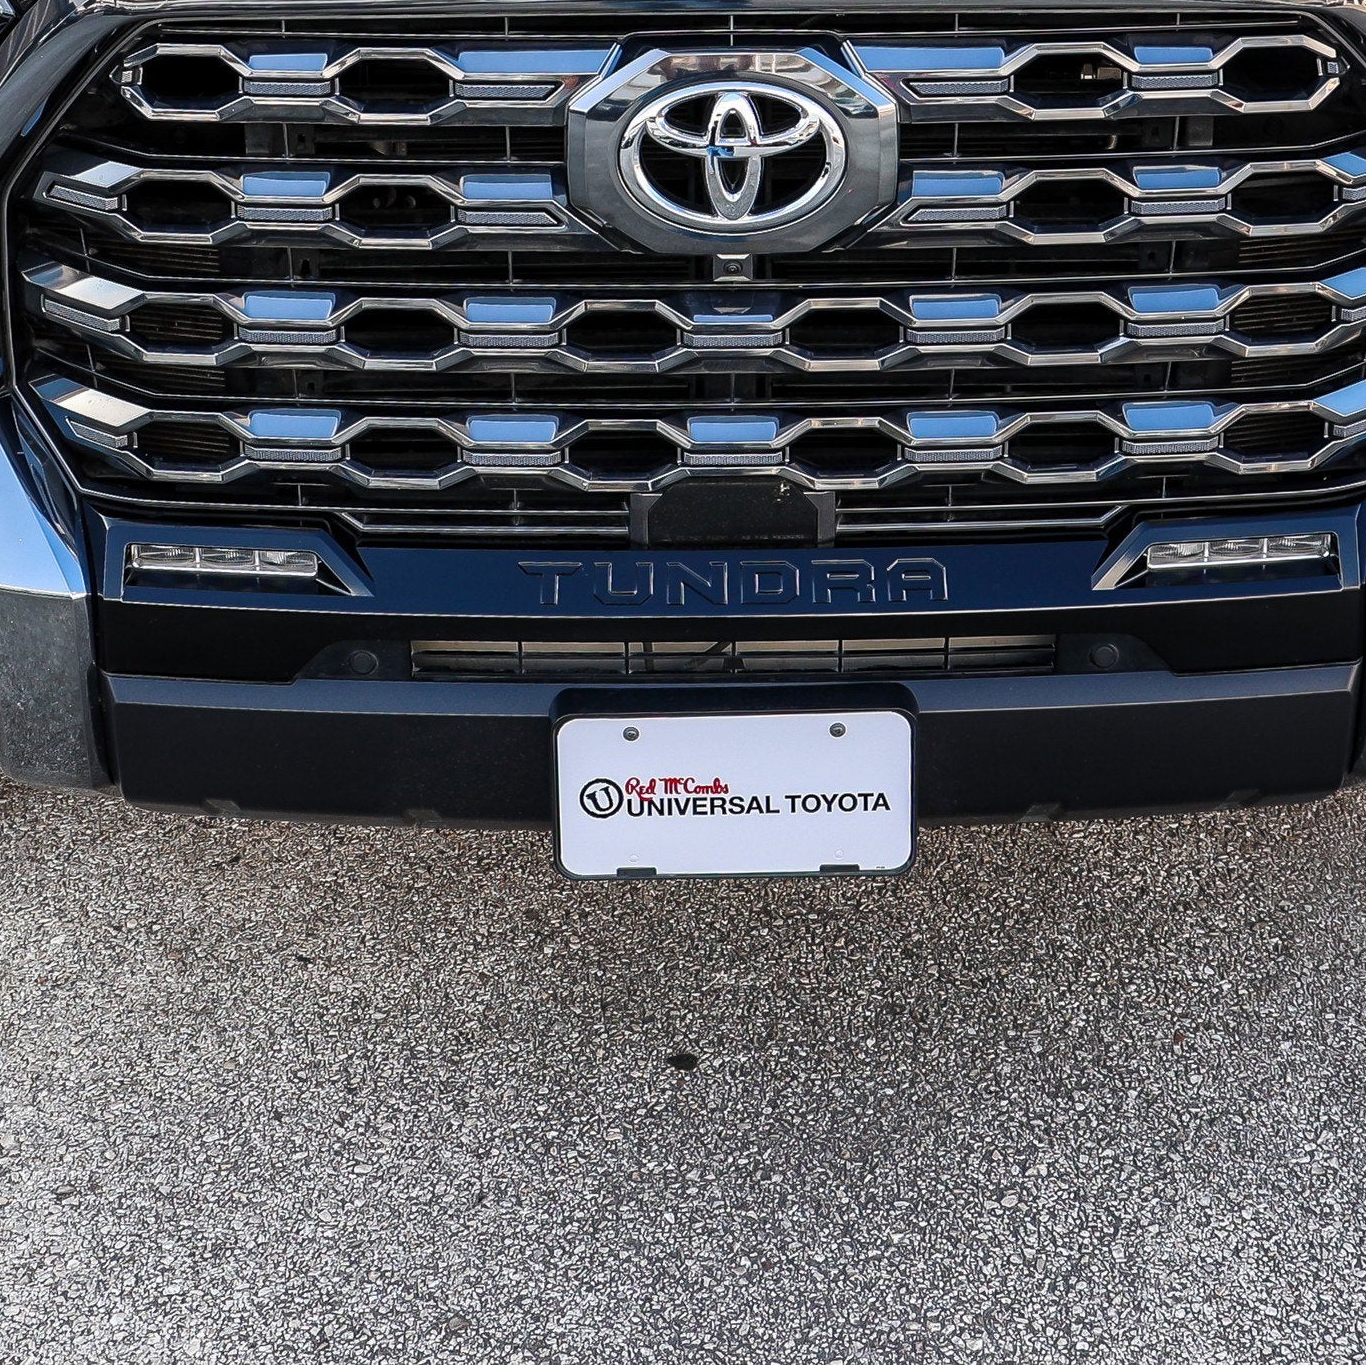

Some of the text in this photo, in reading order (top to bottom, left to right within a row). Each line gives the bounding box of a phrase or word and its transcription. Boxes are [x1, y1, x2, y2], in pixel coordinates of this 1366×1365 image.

[518, 557, 948, 606] TUNDRA
[625, 777, 729, 801] Red McCombs
[627, 793, 891, 817] UNIVERSAL TOYOTA
